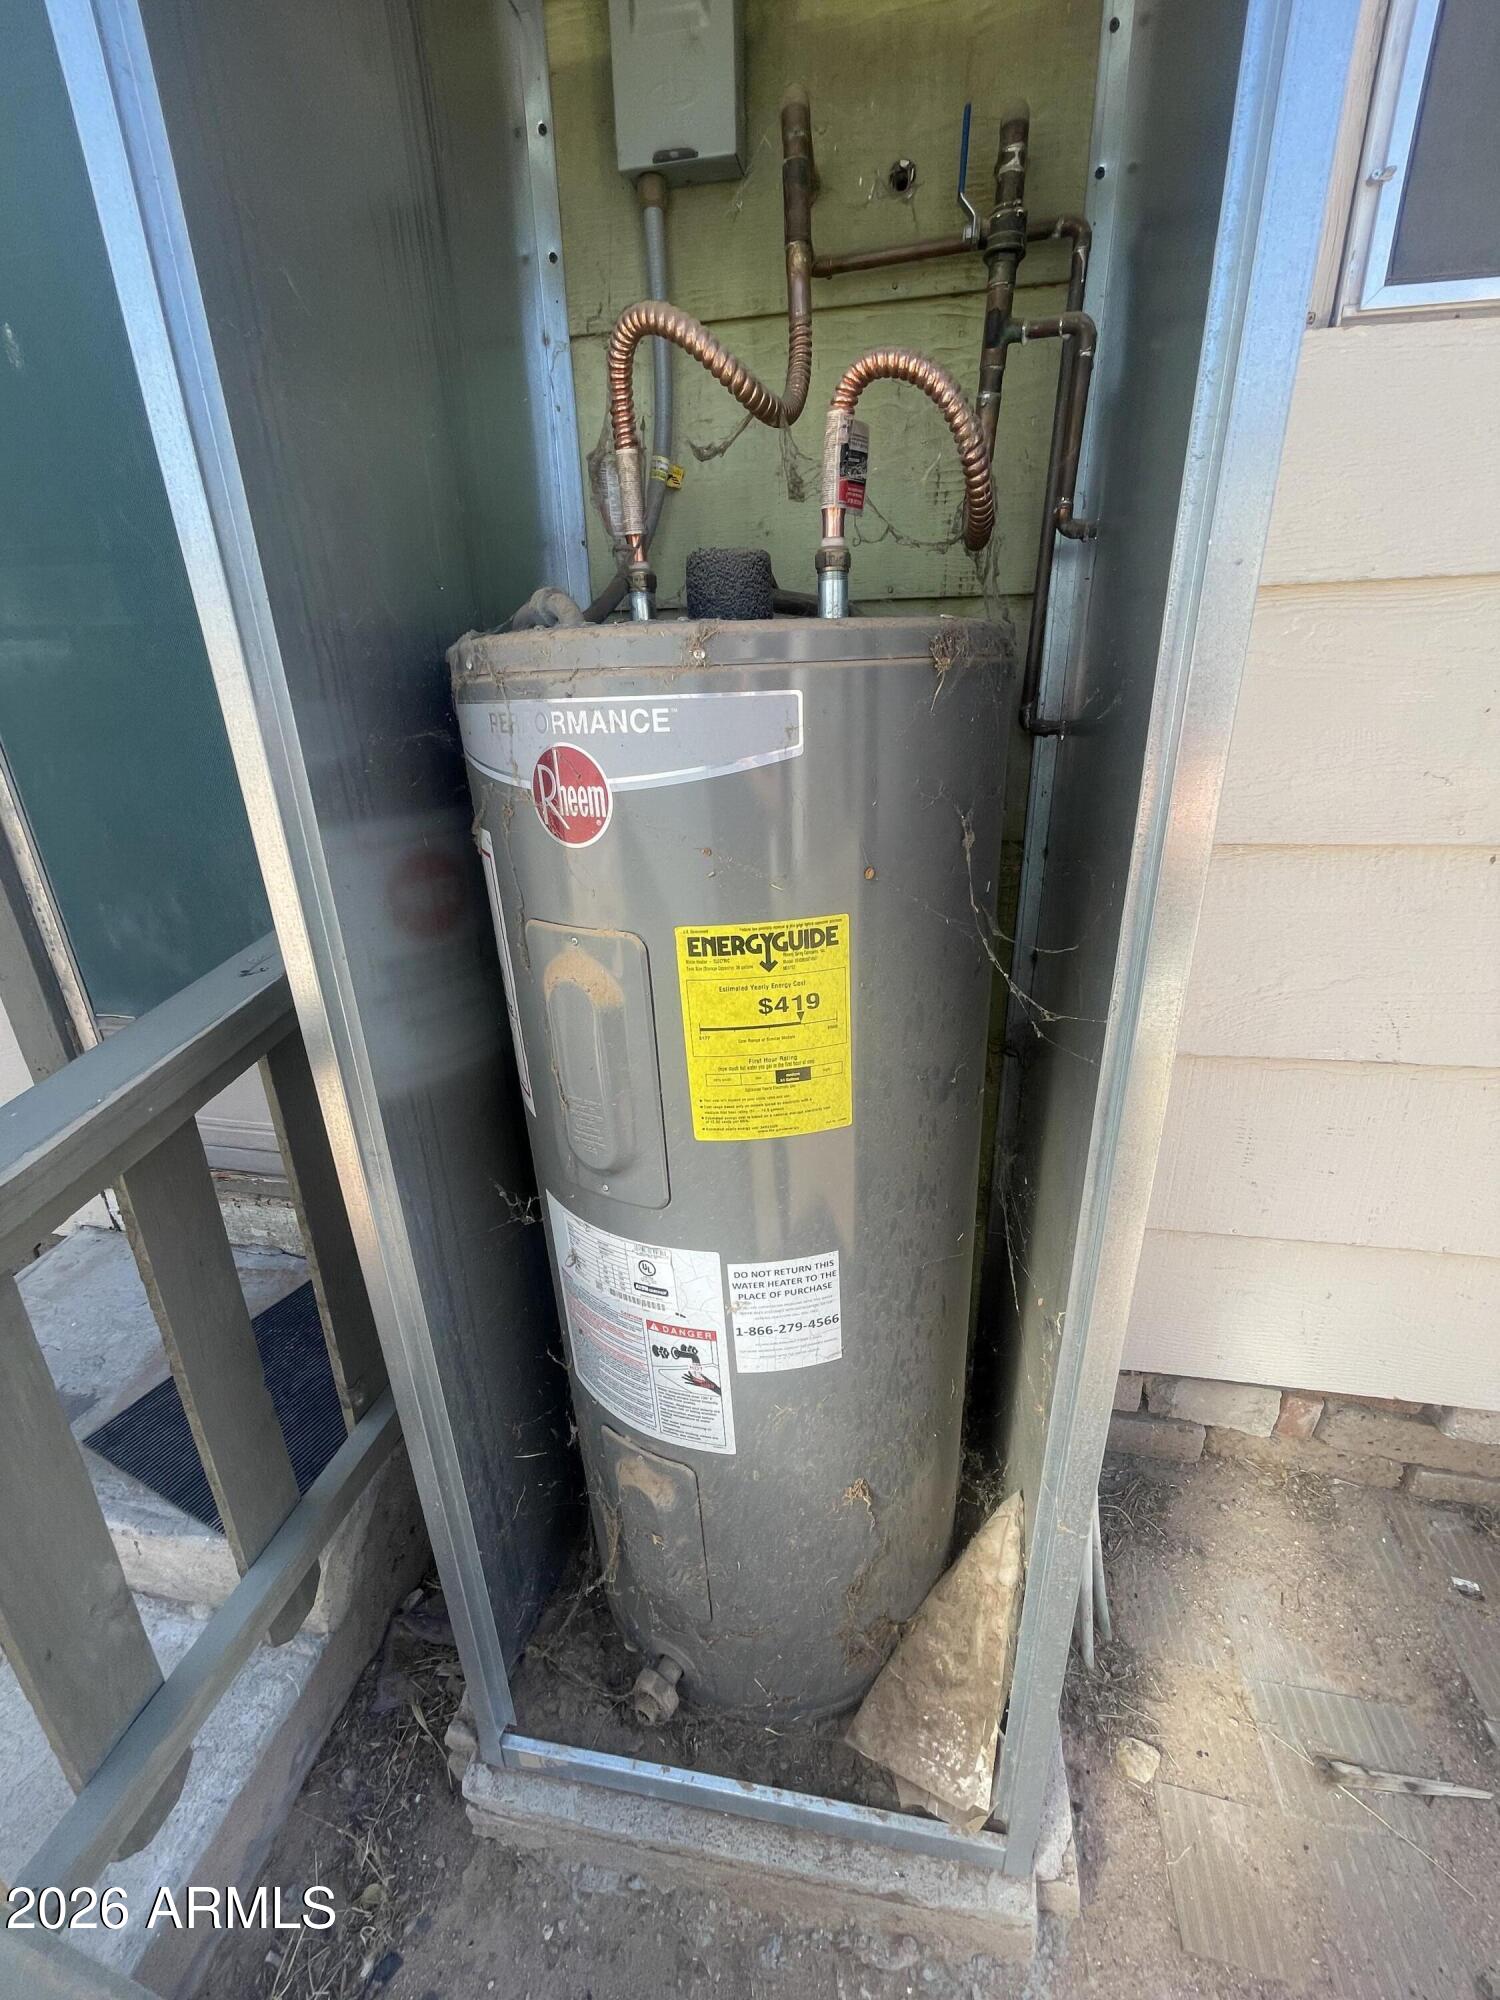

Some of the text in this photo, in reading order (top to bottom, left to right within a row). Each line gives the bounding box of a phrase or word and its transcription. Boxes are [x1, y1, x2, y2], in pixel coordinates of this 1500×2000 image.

[537, 747, 607, 830] Rheem
[687, 925, 839, 958] ENERGYGUIDE
[758, 992, 820, 1016] $419
[732, 1270, 837, 1290] WATER HEATER TO THE
[733, 1259, 835, 1279] DO NOT RETURN THIS
[738, 1282, 833, 1300] PLACE OF PURCHASE
[662, 1323, 712, 1340] DANGER
[736, 1313, 840, 1337] 1-866-279-4566
